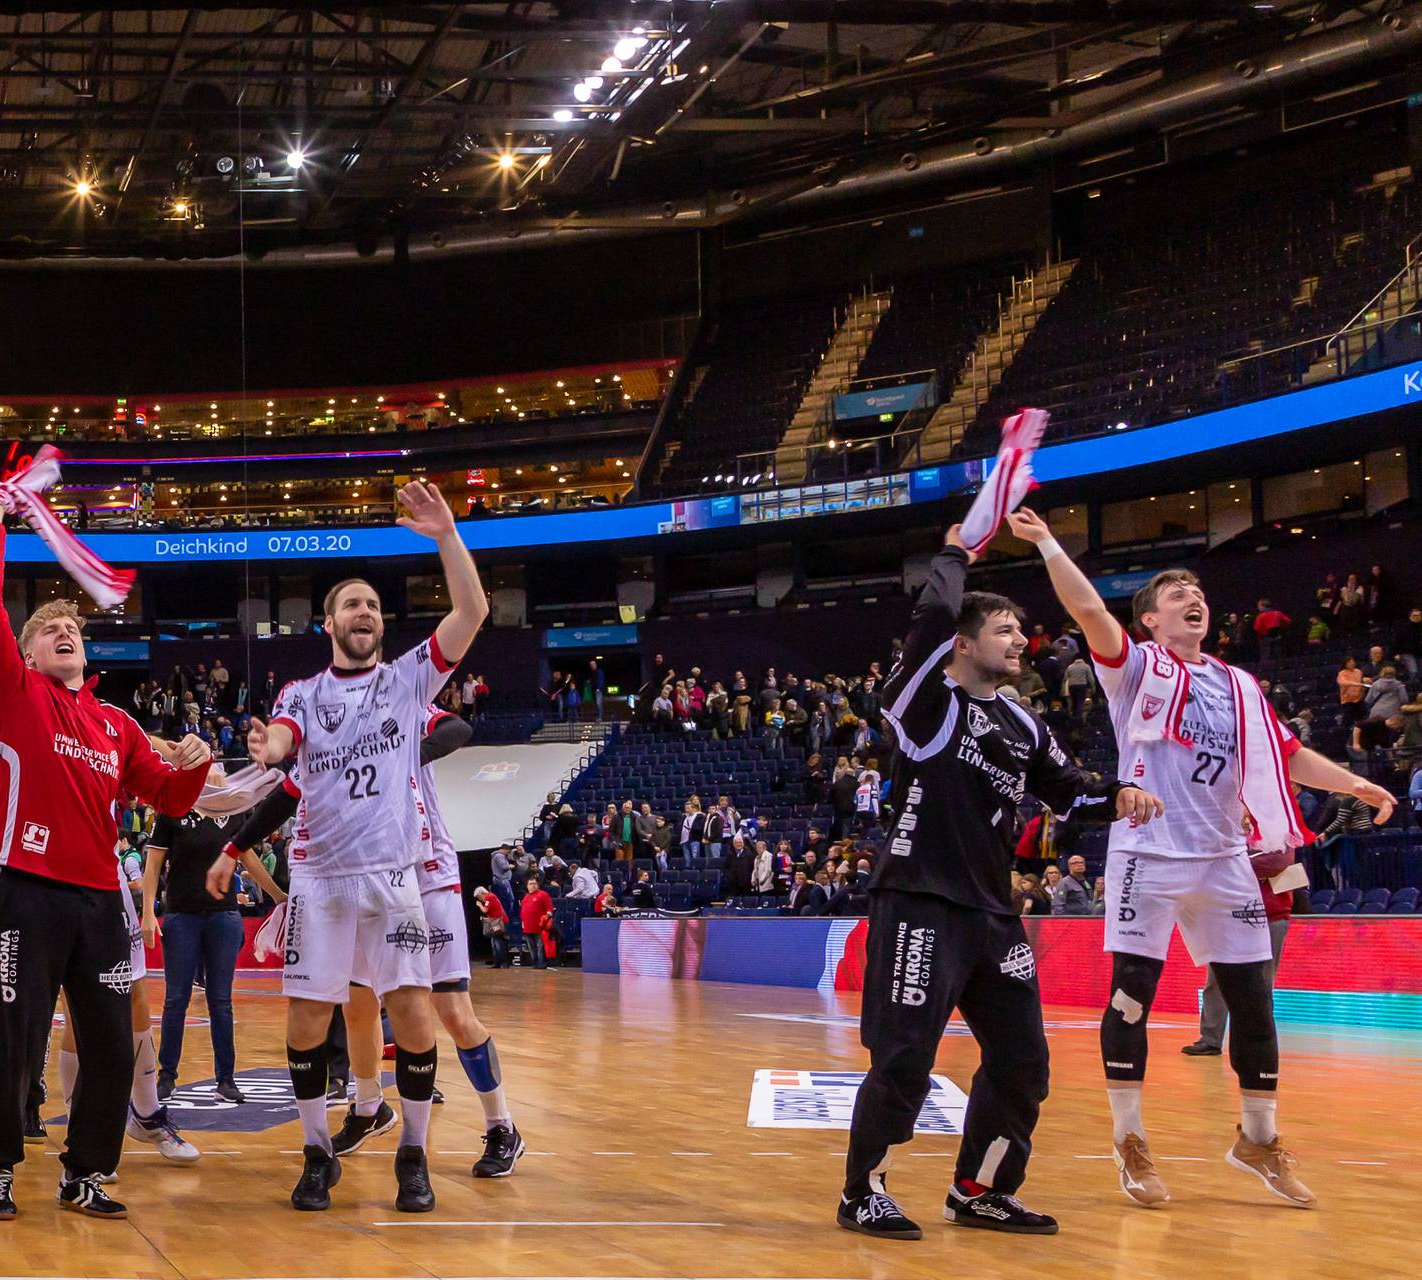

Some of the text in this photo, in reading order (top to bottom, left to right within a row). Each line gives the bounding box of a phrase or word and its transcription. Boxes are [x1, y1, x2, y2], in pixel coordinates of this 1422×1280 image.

[155, 537, 248, 555] Deichkind
[268, 535, 352, 553] 07.03.20
[345, 764, 380, 800] 22
[1191, 752, 1227, 787] 27
[389, 870, 405, 888] 22
[1121, 857, 1138, 904] KRONA
[287, 895, 299, 946] KRONA
[294, 894, 305, 947] COATINGS
[0, 930, 12, 983] KRONA
[9, 930, 20, 984] COATINGS
[891, 922, 908, 1003] PRO TRAINING
[920, 929, 935, 986] COATINGS
[408, 1063, 434, 1072] SELECT
[971, 1201, 1011, 1220] Salming
